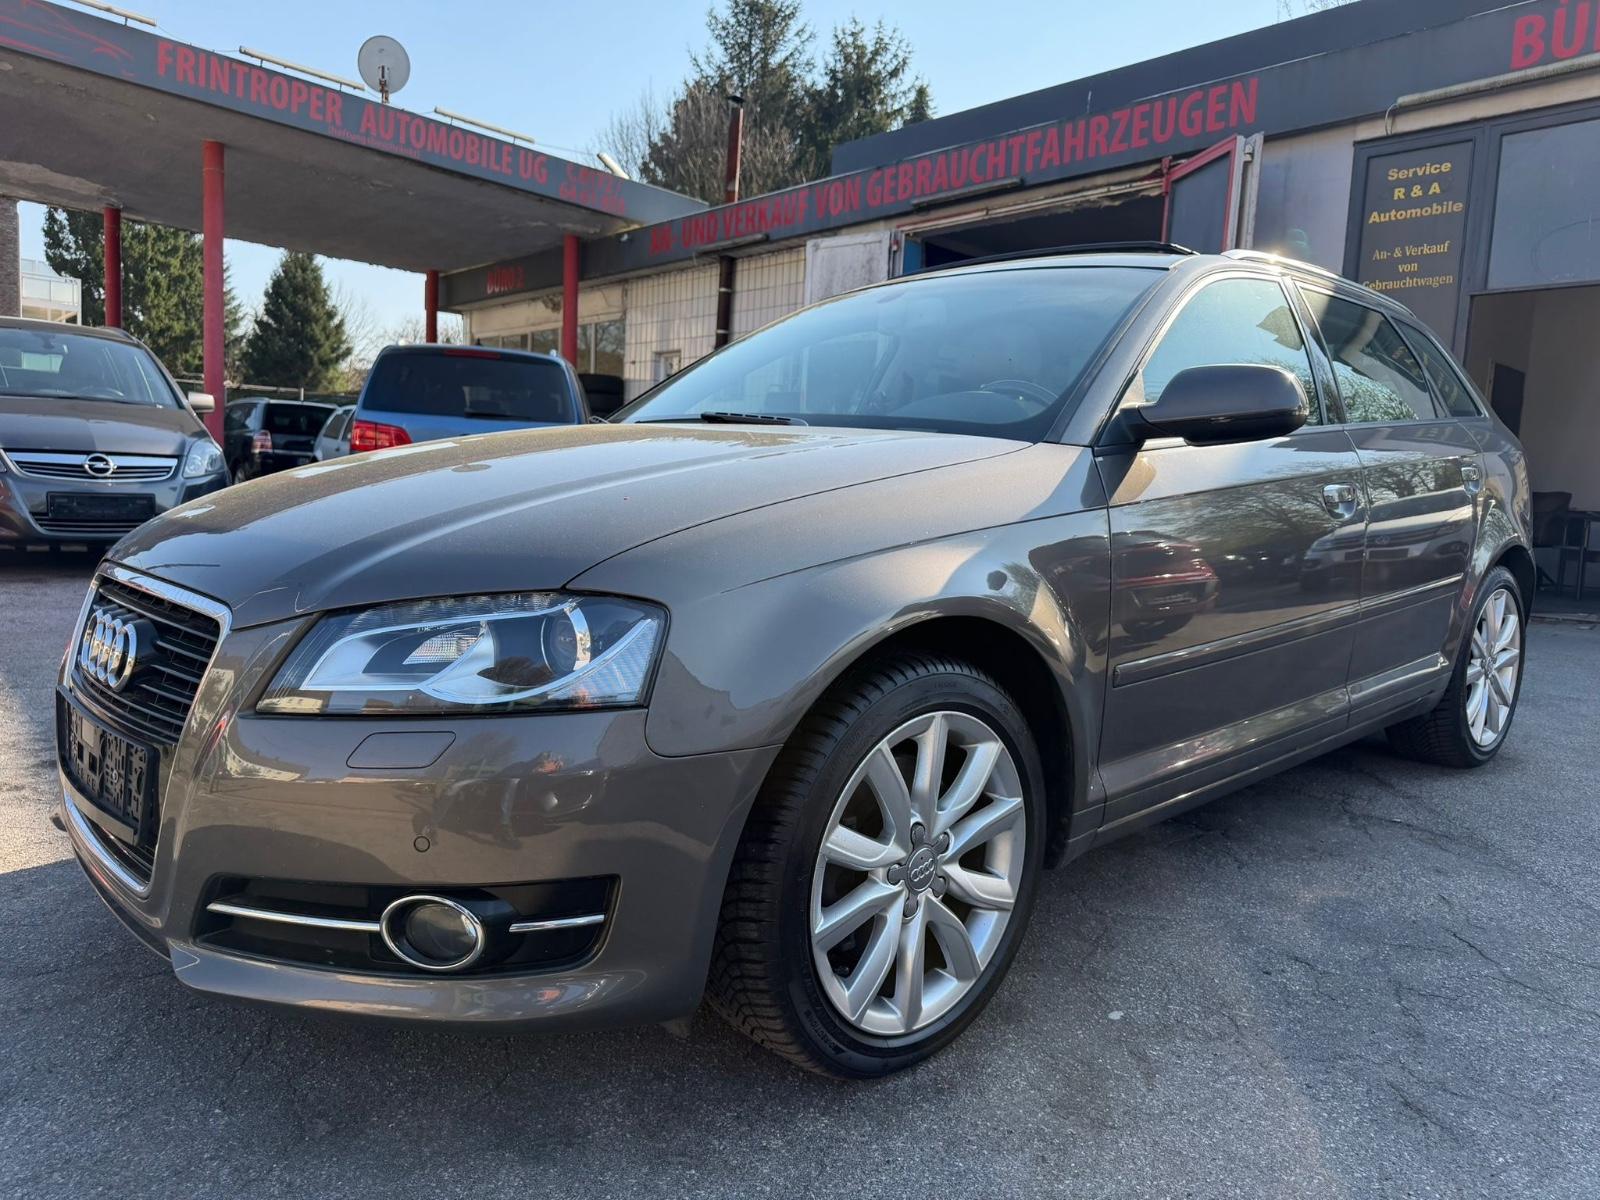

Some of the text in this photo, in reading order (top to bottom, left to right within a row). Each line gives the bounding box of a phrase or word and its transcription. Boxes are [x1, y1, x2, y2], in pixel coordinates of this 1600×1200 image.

[157, 40, 343, 126] FRINTROPER
[360, 103, 512, 175] AUTOMOBILE
[519, 150, 548, 183] UG
[682, 211, 719, 249] UND
[722, 189, 809, 240] VERKAUF
[815, 179, 861, 219] VON
[866, 78, 1259, 207] GEBRAUCHTFAHRZEUGEN
[1387, 161, 1452, 181] Service
[1393, 181, 1441, 200] R & A
[1368, 200, 1464, 224] Automobile
[1372, 240, 1451, 261] An- & Verkauf
[1398, 262, 1418, 272] von
